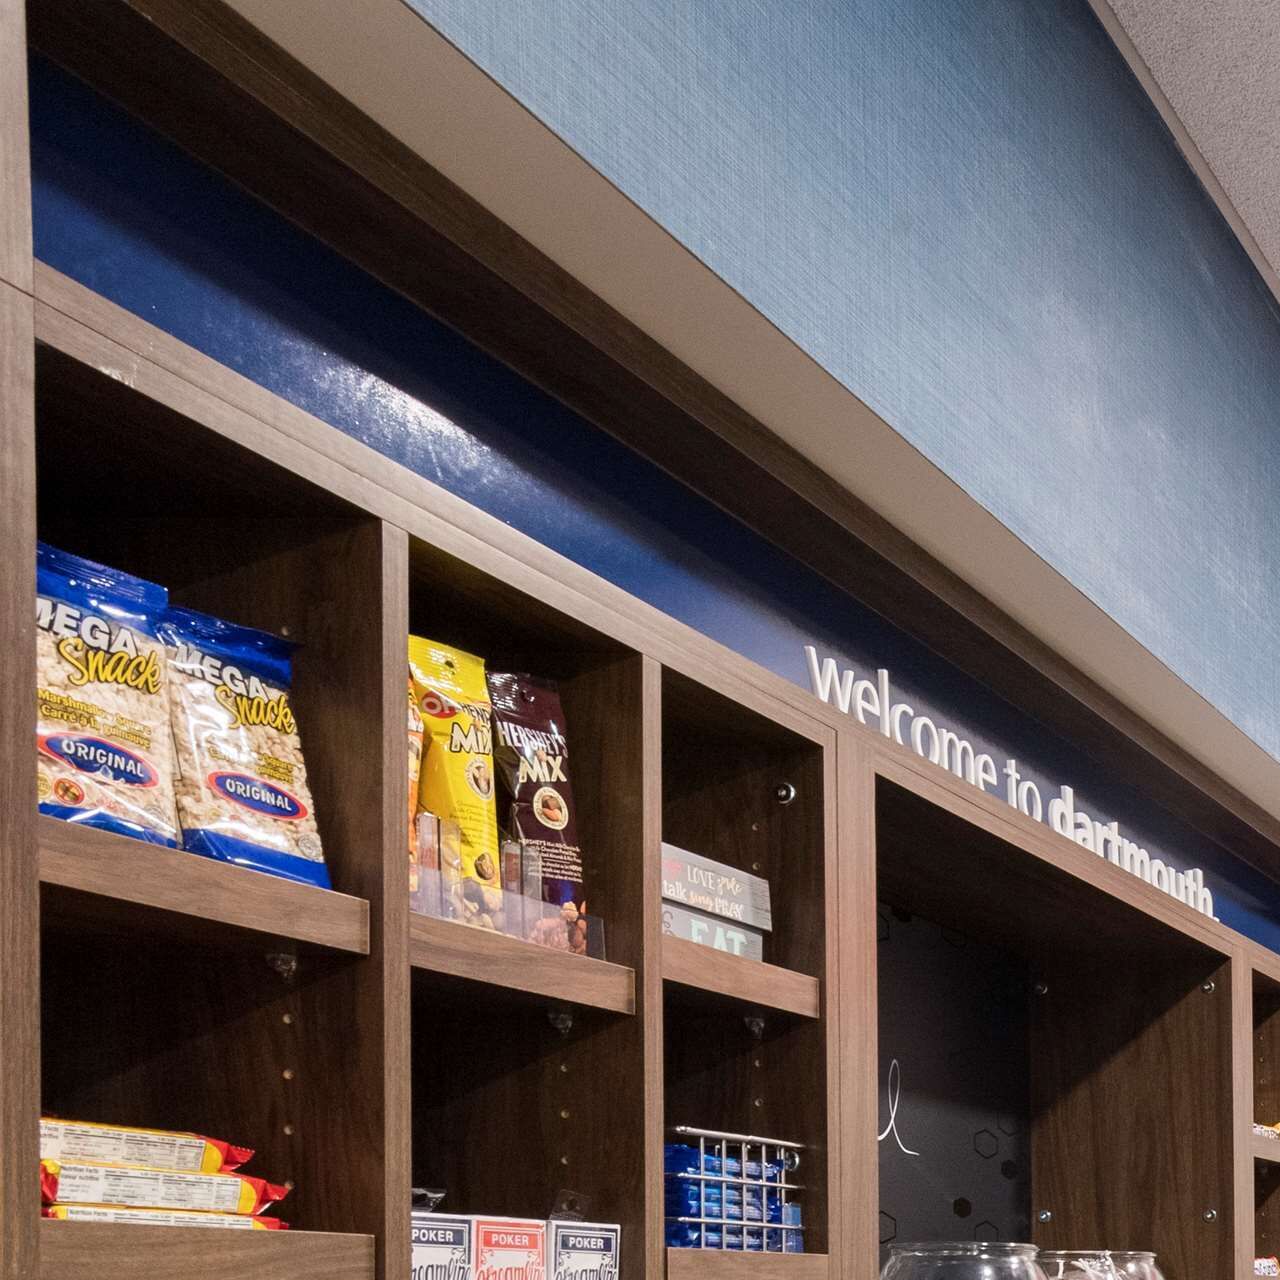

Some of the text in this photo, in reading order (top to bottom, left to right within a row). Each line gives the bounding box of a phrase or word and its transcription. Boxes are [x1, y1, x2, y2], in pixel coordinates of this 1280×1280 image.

[36, 597, 138, 656] MEGA
[58, 637, 163, 694] Snack
[174, 645, 281, 703] MEGA
[214, 685, 298, 736] Snack
[804, 645, 998, 791] welcome
[1003, 759, 1042, 823] to
[61, 738, 145, 778] ORIGINAL
[225, 777, 292, 814] ORIGINAL
[412, 1230, 454, 1243] POKER
[491, 1233, 529, 1246] POKER
[568, 1236, 604, 1249] POKER
